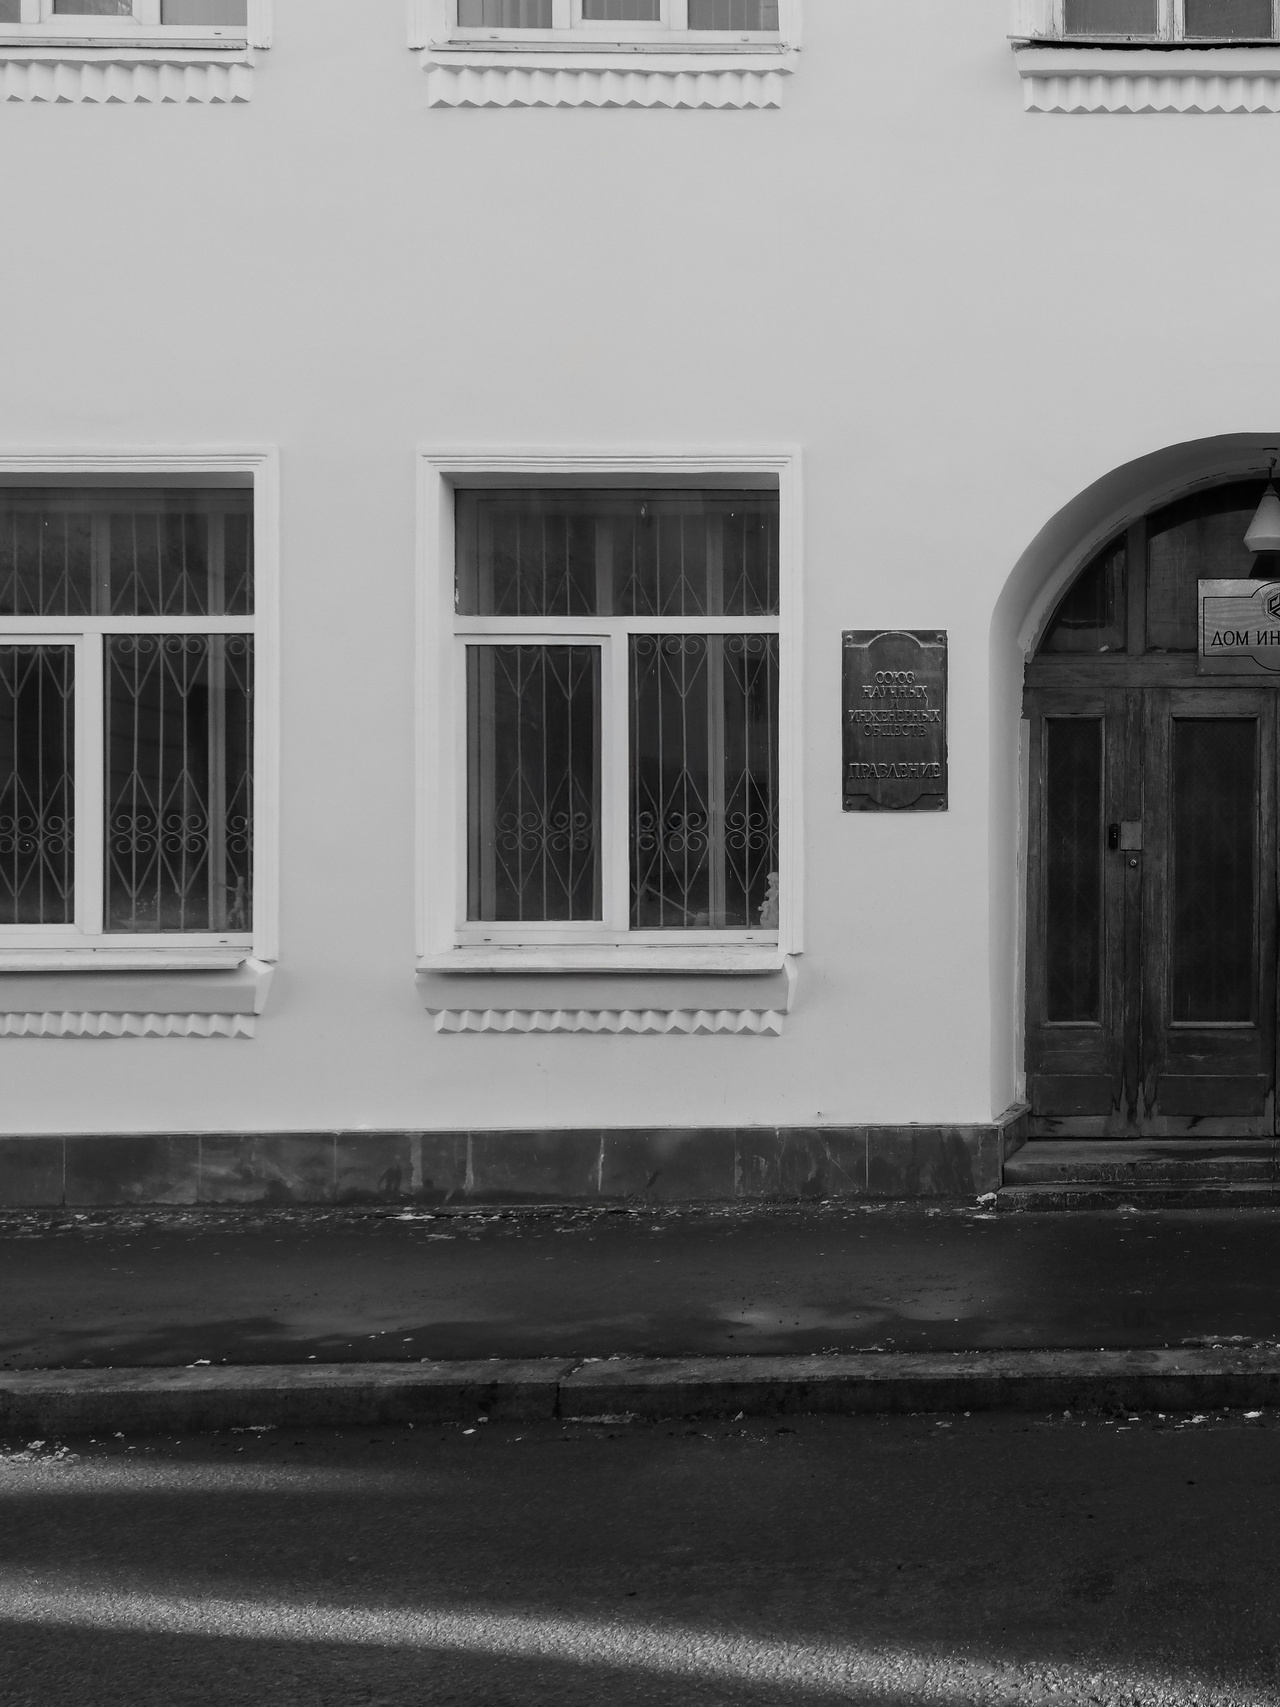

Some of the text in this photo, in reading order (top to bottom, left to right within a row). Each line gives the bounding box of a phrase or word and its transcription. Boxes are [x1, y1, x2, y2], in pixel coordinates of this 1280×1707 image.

[1211, 630, 1249, 647] ДОМ
[875, 671, 915, 684] СОЮЗ
[861, 685, 928, 699] НАУЧНЫХ
[848, 709, 940, 722] ИНЖЕНЕРНЫХ
[863, 723, 928, 736] ОБЩЕСТВ
[848, 762, 941, 778] ПРАВЛЕНИЕ
